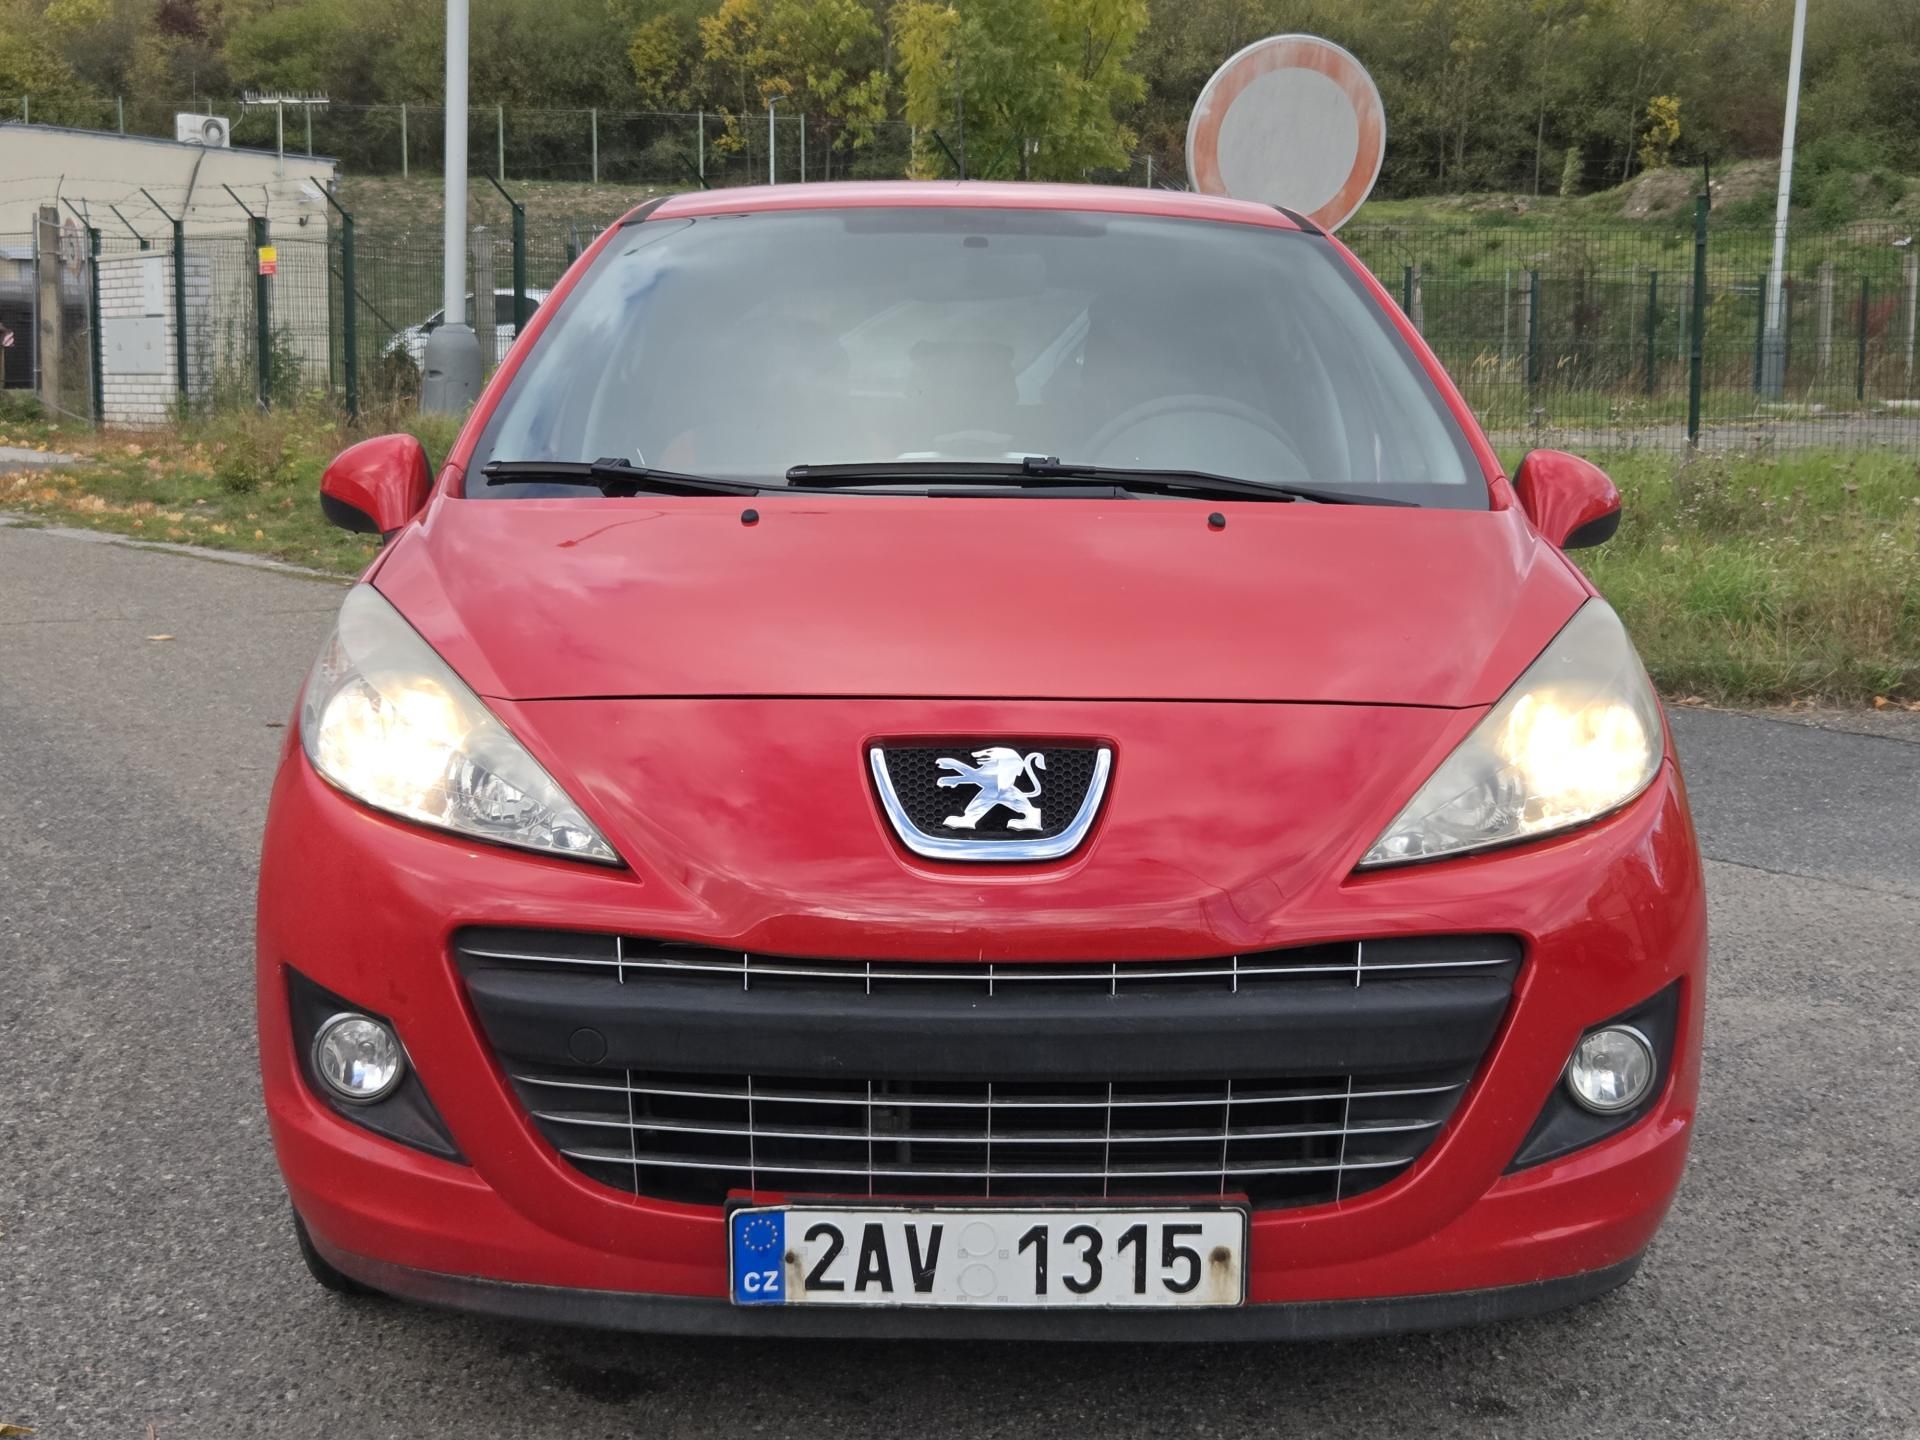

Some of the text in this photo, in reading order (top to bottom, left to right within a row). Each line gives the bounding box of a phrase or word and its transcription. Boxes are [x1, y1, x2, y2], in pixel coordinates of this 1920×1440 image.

[743, 1270, 779, 1293] CZ
[804, 1223, 1203, 1294] 2AV 1315
